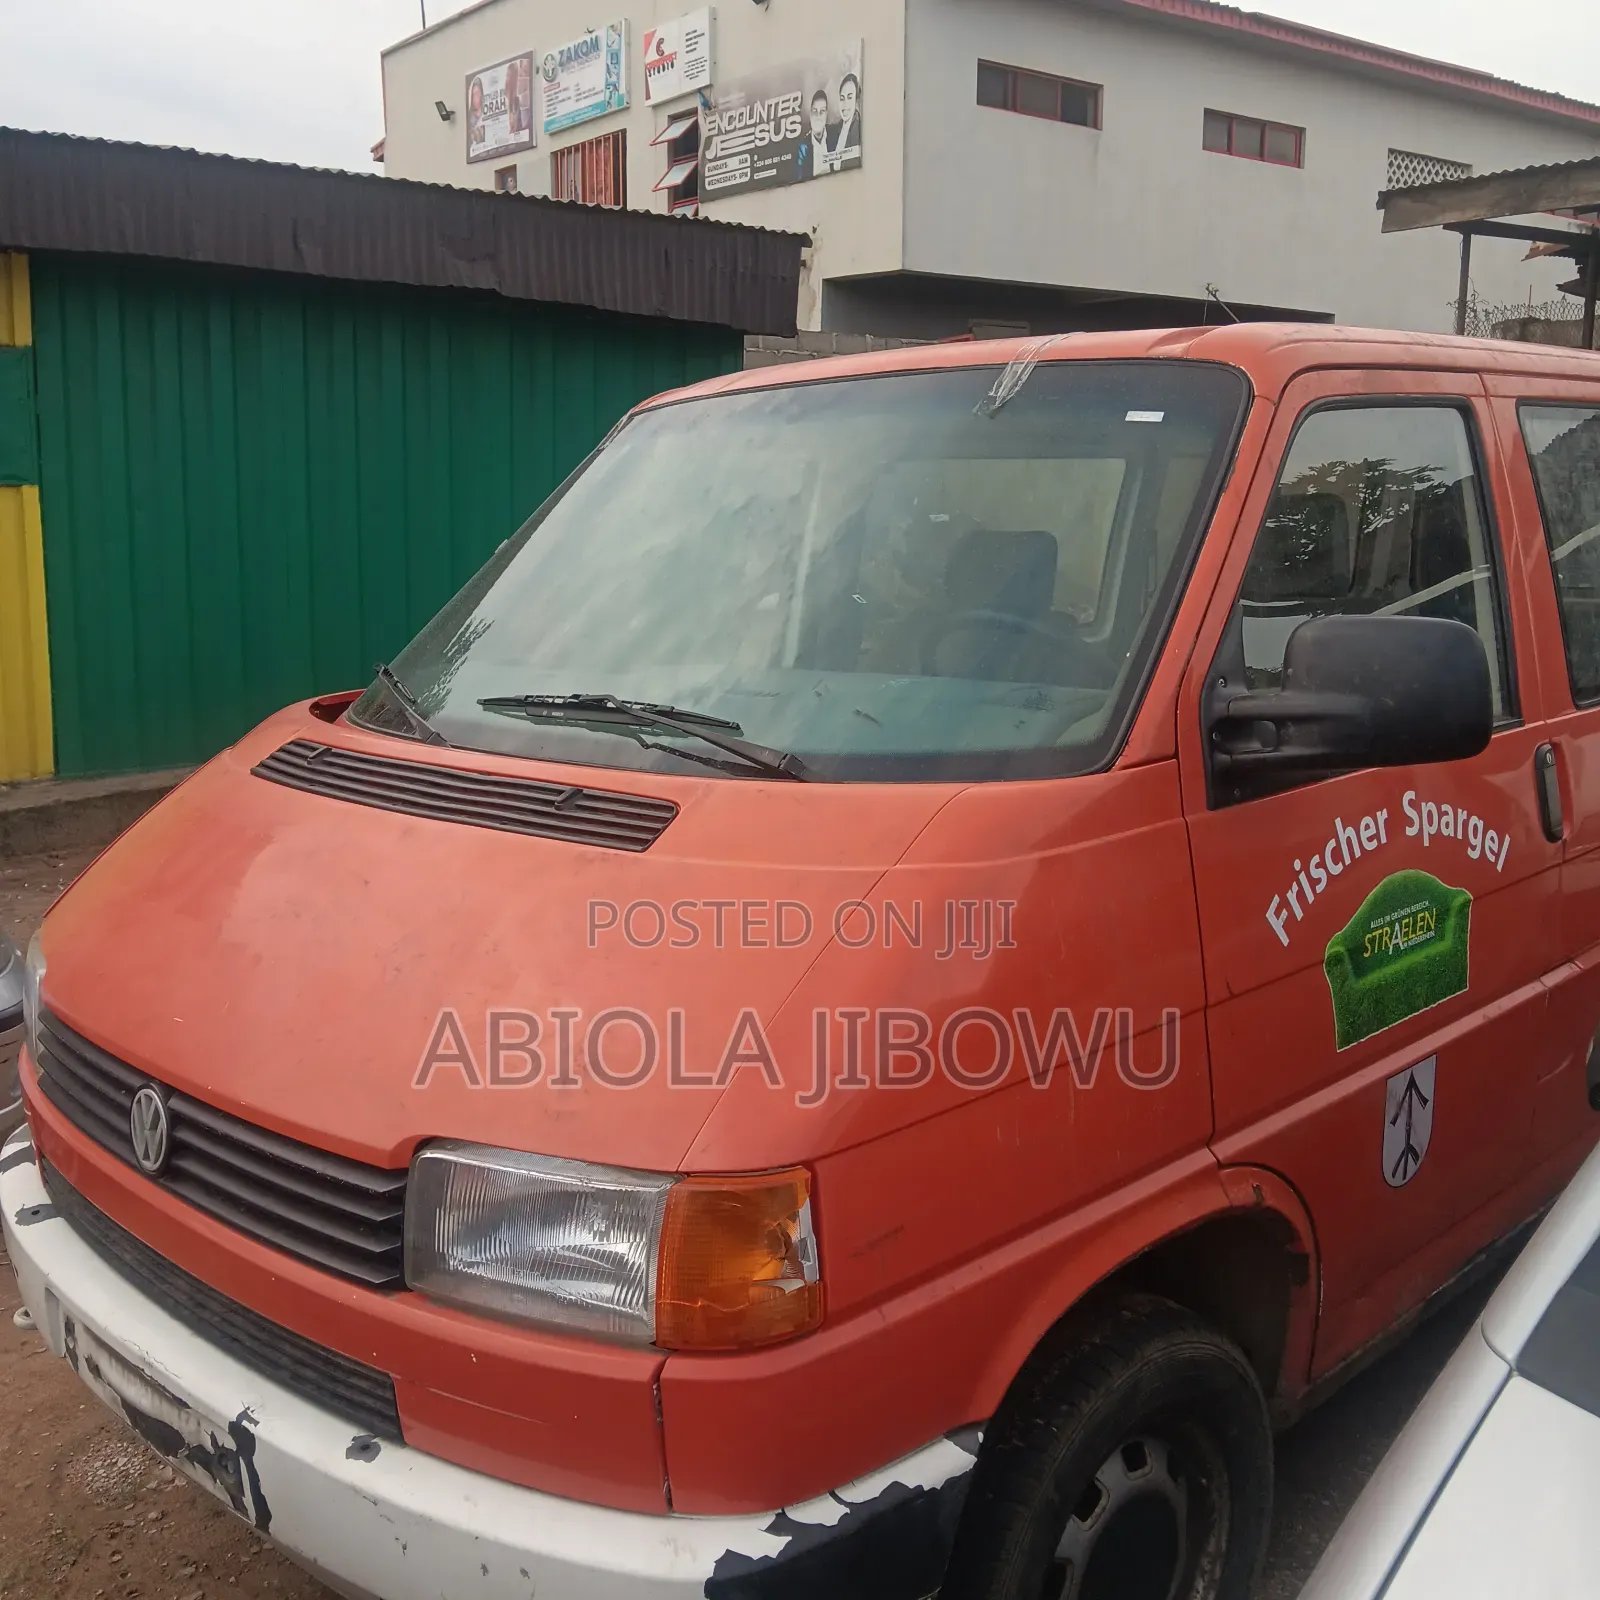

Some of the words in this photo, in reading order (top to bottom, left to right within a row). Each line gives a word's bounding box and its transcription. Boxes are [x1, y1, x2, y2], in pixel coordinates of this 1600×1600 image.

[558, 35, 601, 67] ZAKOM
[704, 90, 803, 137] ENCOUNTER
[705, 115, 802, 160] JESUS
[1265, 808, 1389, 947] Frischer
[1402, 790, 1511, 873] Spargel
[1363, 907, 1436, 957] STRAELEN
